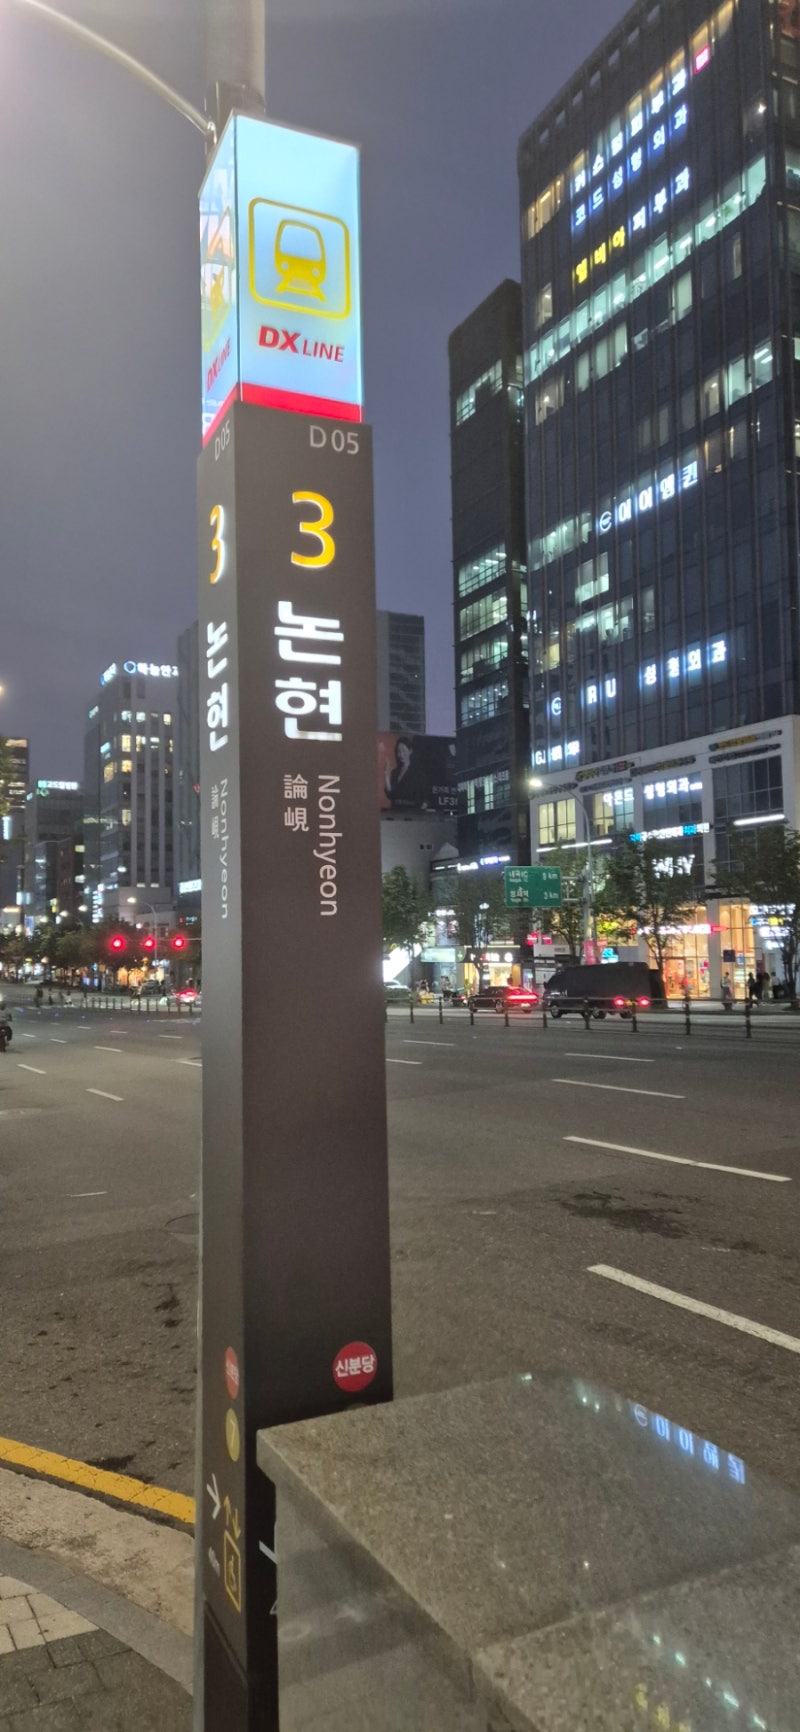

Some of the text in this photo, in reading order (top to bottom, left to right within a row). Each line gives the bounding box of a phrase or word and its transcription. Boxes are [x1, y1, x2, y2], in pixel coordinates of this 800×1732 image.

[258, 324, 344, 363] DX LINE
[209, 504, 227, 584] 3
[290, 490, 336, 569] 3
[206, 621, 230, 752] 논현
[274, 600, 344, 742] 논현
[284, 773, 309, 832] 論峴
[218, 778, 230, 919] Nonhyeon
[313, 774, 343, 916] Nonhyeon
[335, 1355, 375, 1378] 신분당
